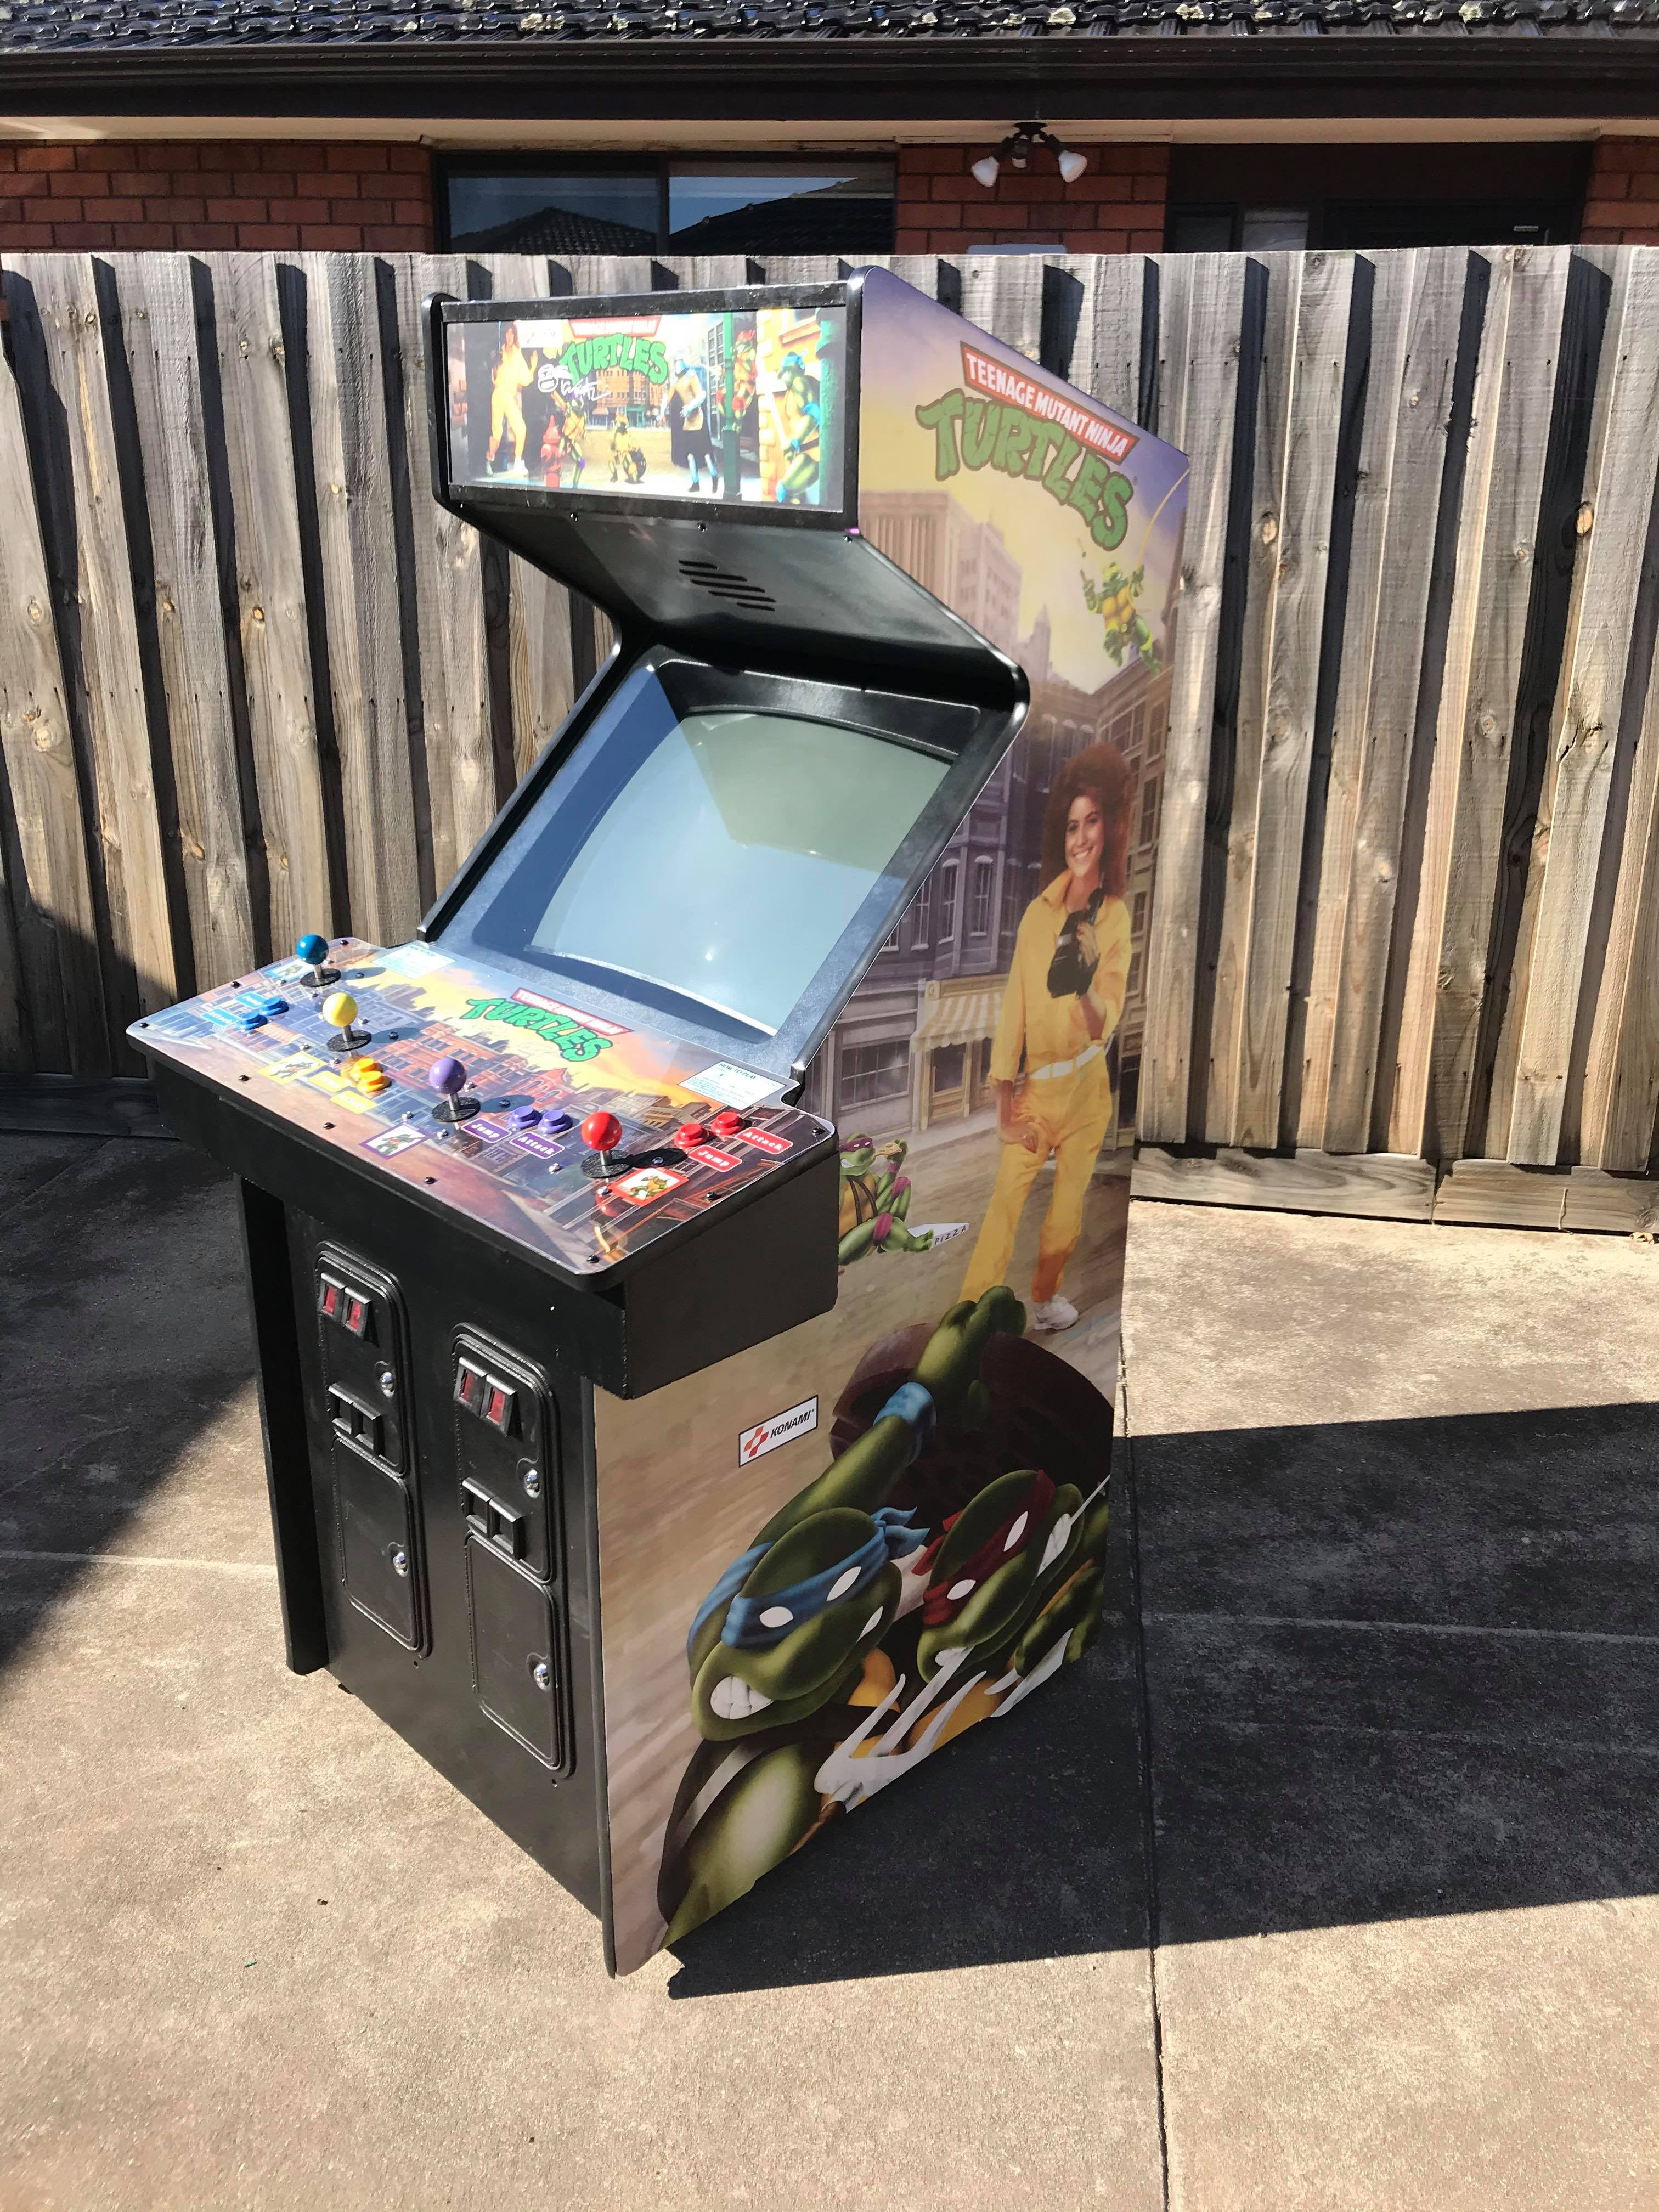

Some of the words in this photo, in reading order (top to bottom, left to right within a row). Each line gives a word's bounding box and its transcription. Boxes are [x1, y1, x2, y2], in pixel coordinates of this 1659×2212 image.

[559, 333, 668, 385] TURTLES
[966, 353, 1035, 409] TEENAGE
[1034, 391, 1089, 437] MUTANT
[1084, 420, 1129, 457] NINJA
[915, 388, 1133, 551] TURTLES
[459, 998, 613, 1062] TURTLES
[741, 1071, 757, 1080] PLAY
[517, 1136, 555, 1155] Attack
[743, 1132, 783, 1150] Attack
[934, 1225, 966, 1246] PIZZA
[770, 1410, 811, 1438] KONAMI
